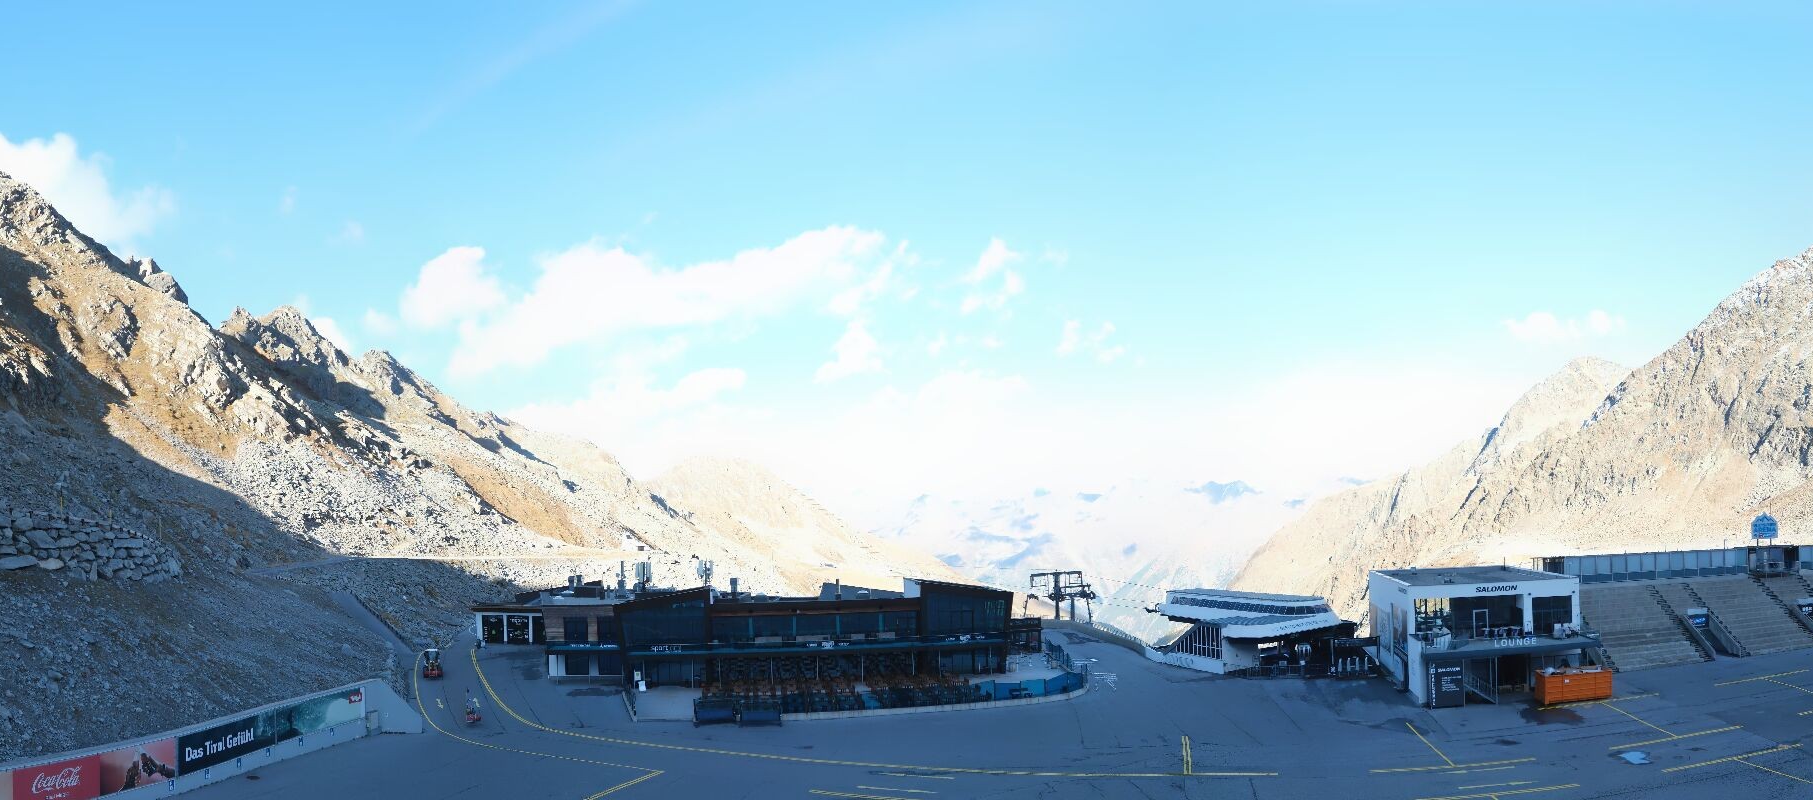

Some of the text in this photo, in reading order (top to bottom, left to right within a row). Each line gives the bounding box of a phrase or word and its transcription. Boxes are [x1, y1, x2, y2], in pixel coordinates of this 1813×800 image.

[1475, 585, 1518, 593] SALOMON
[1494, 637, 1537, 648] LOUNGE
[185, 727, 255, 762] Das Tirol Gefühl
